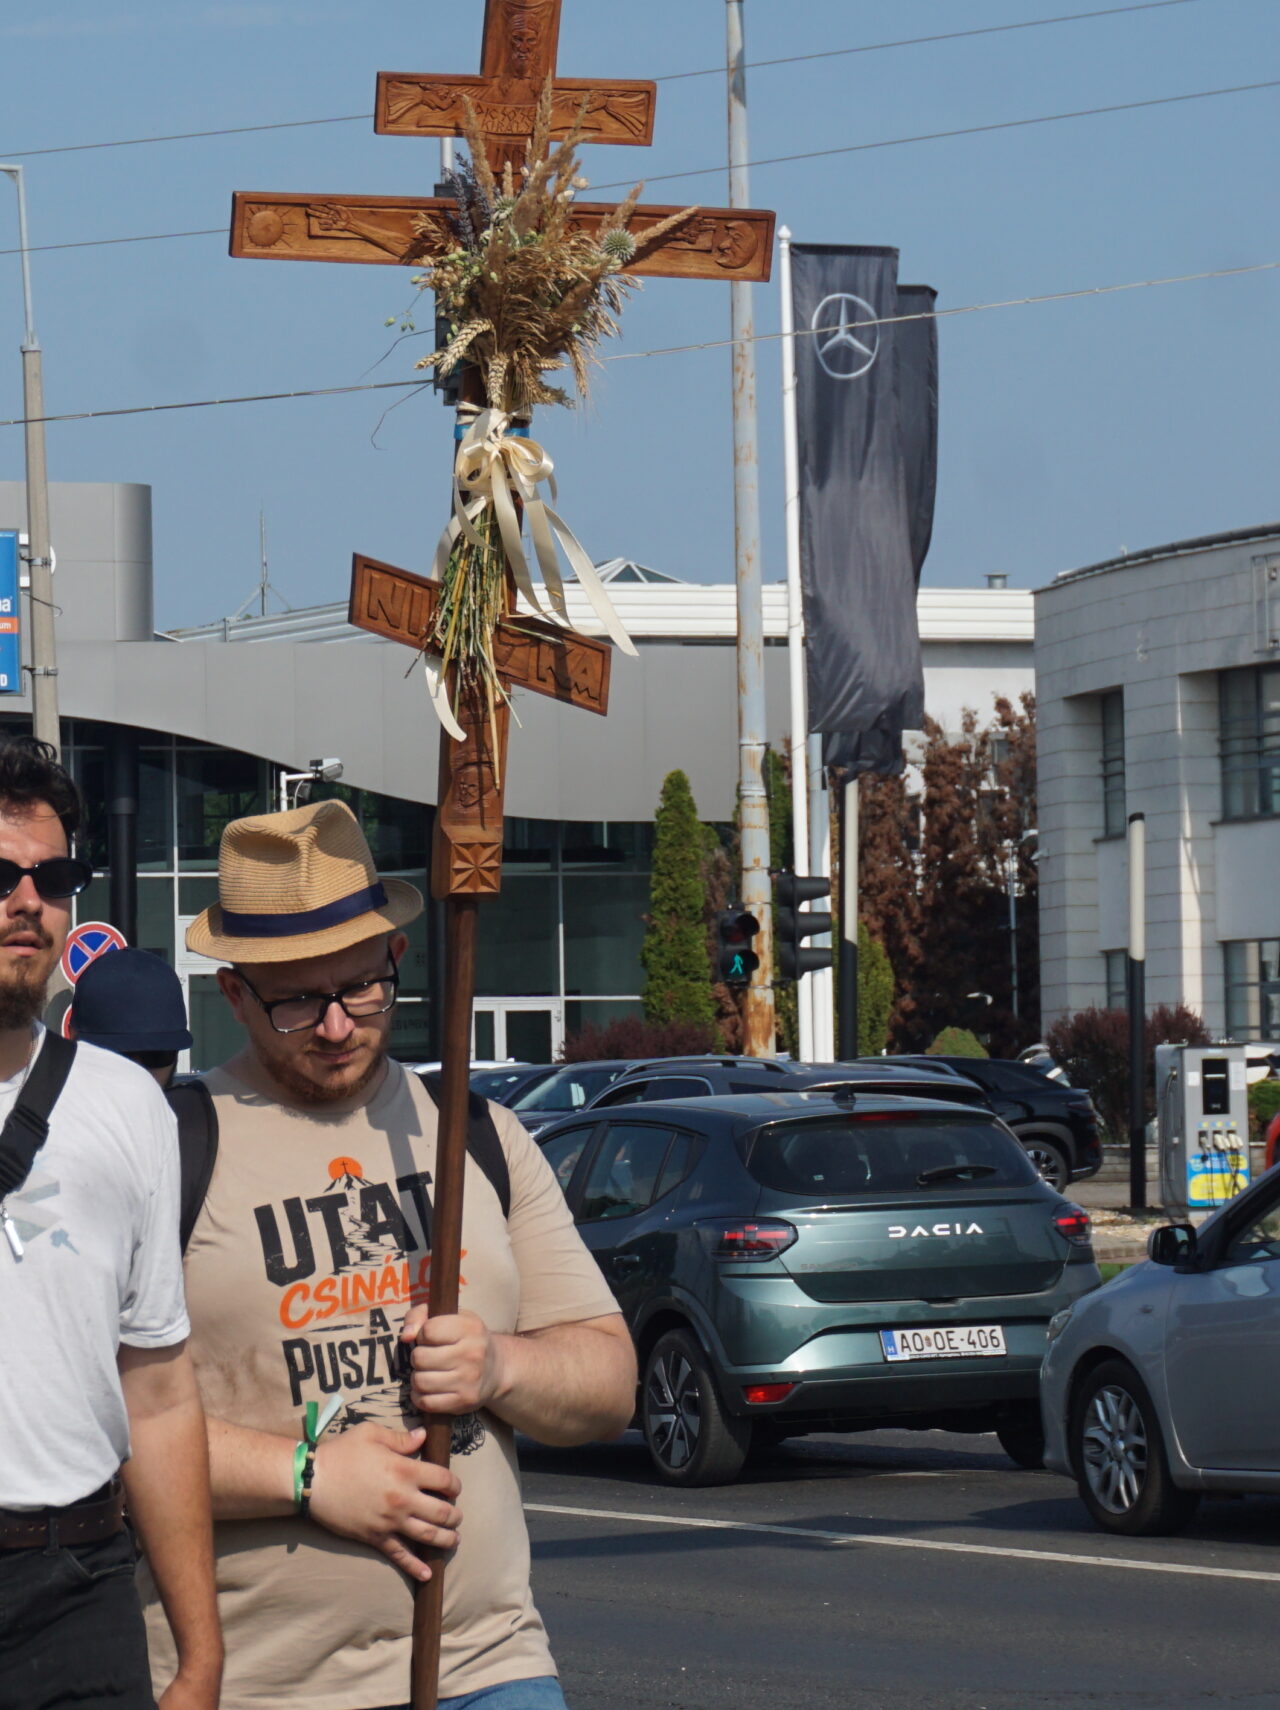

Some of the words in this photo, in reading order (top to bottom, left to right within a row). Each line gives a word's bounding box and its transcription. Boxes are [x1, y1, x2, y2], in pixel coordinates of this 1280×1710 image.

[254, 1171, 434, 1287] UTAT
[888, 1223, 984, 1238] DACIA
[369, 1308, 391, 1334] A
